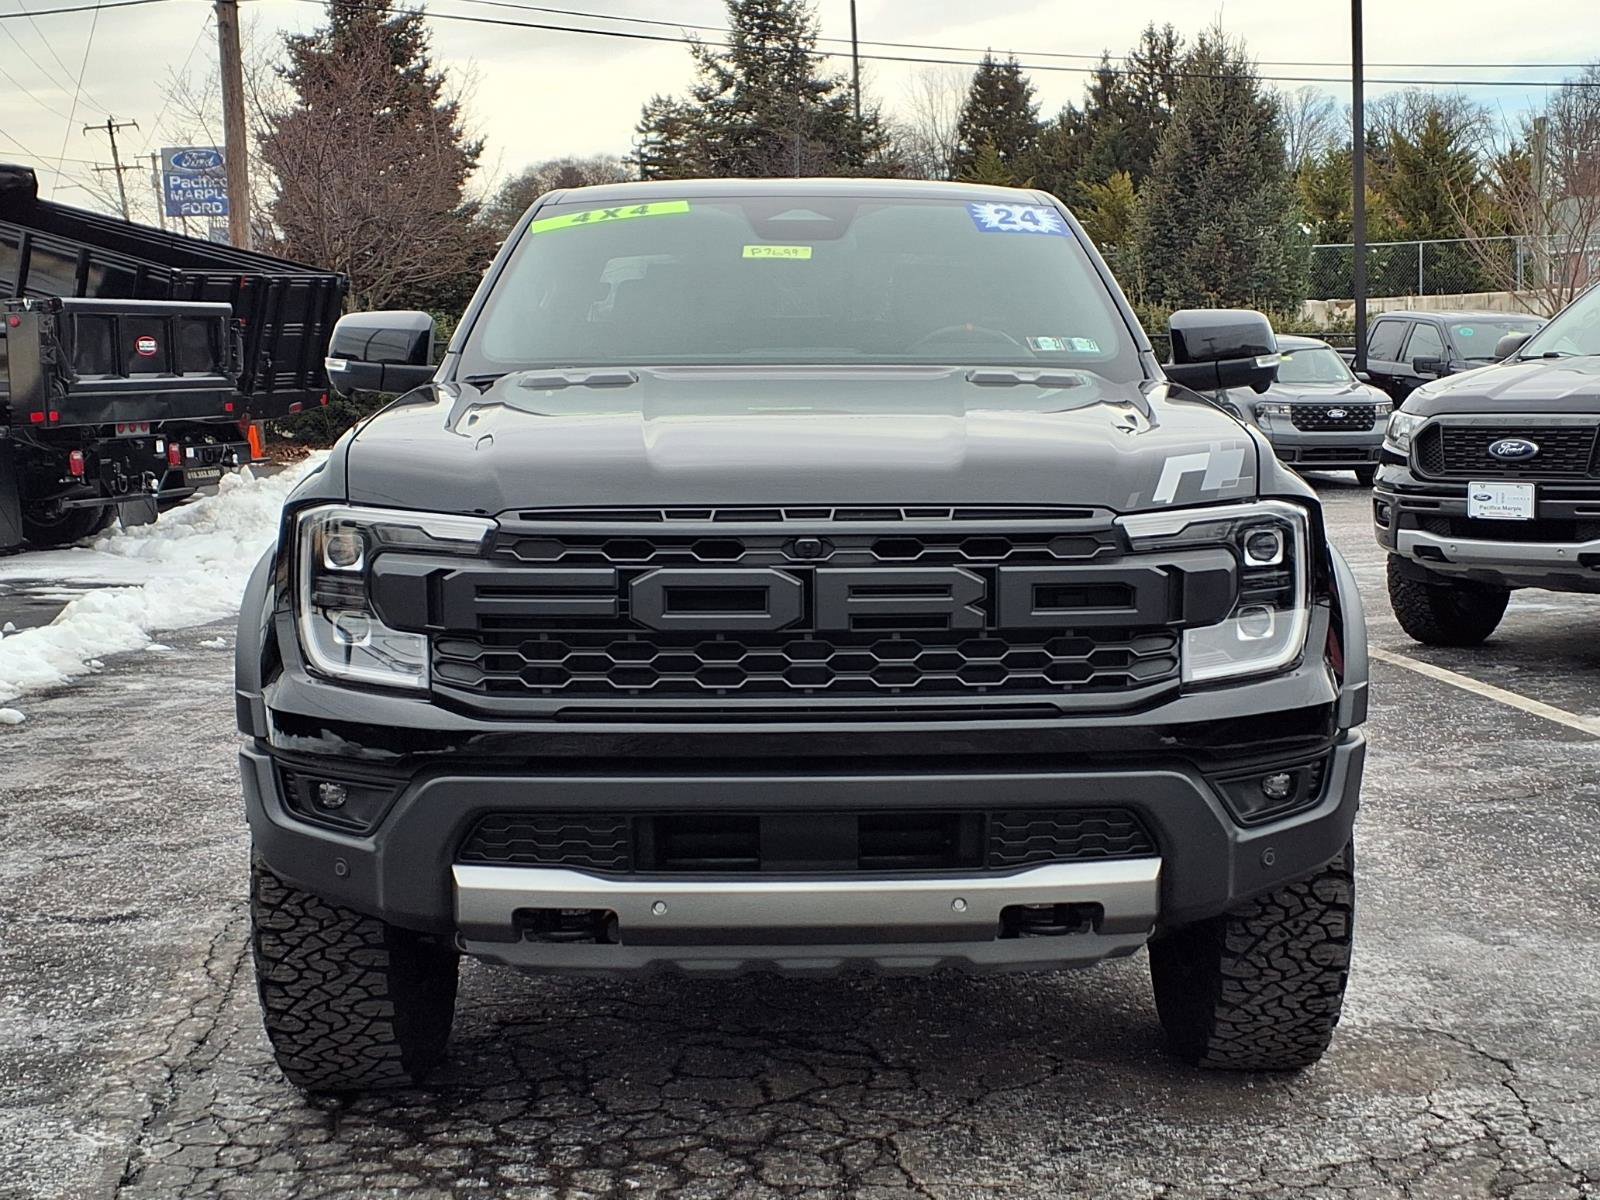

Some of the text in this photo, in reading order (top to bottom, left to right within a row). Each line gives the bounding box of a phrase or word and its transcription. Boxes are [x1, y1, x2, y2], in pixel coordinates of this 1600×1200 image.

[181, 202, 223, 214] FORD
[993, 208, 1040, 226] 24
[438, 564, 1172, 633] FORD
